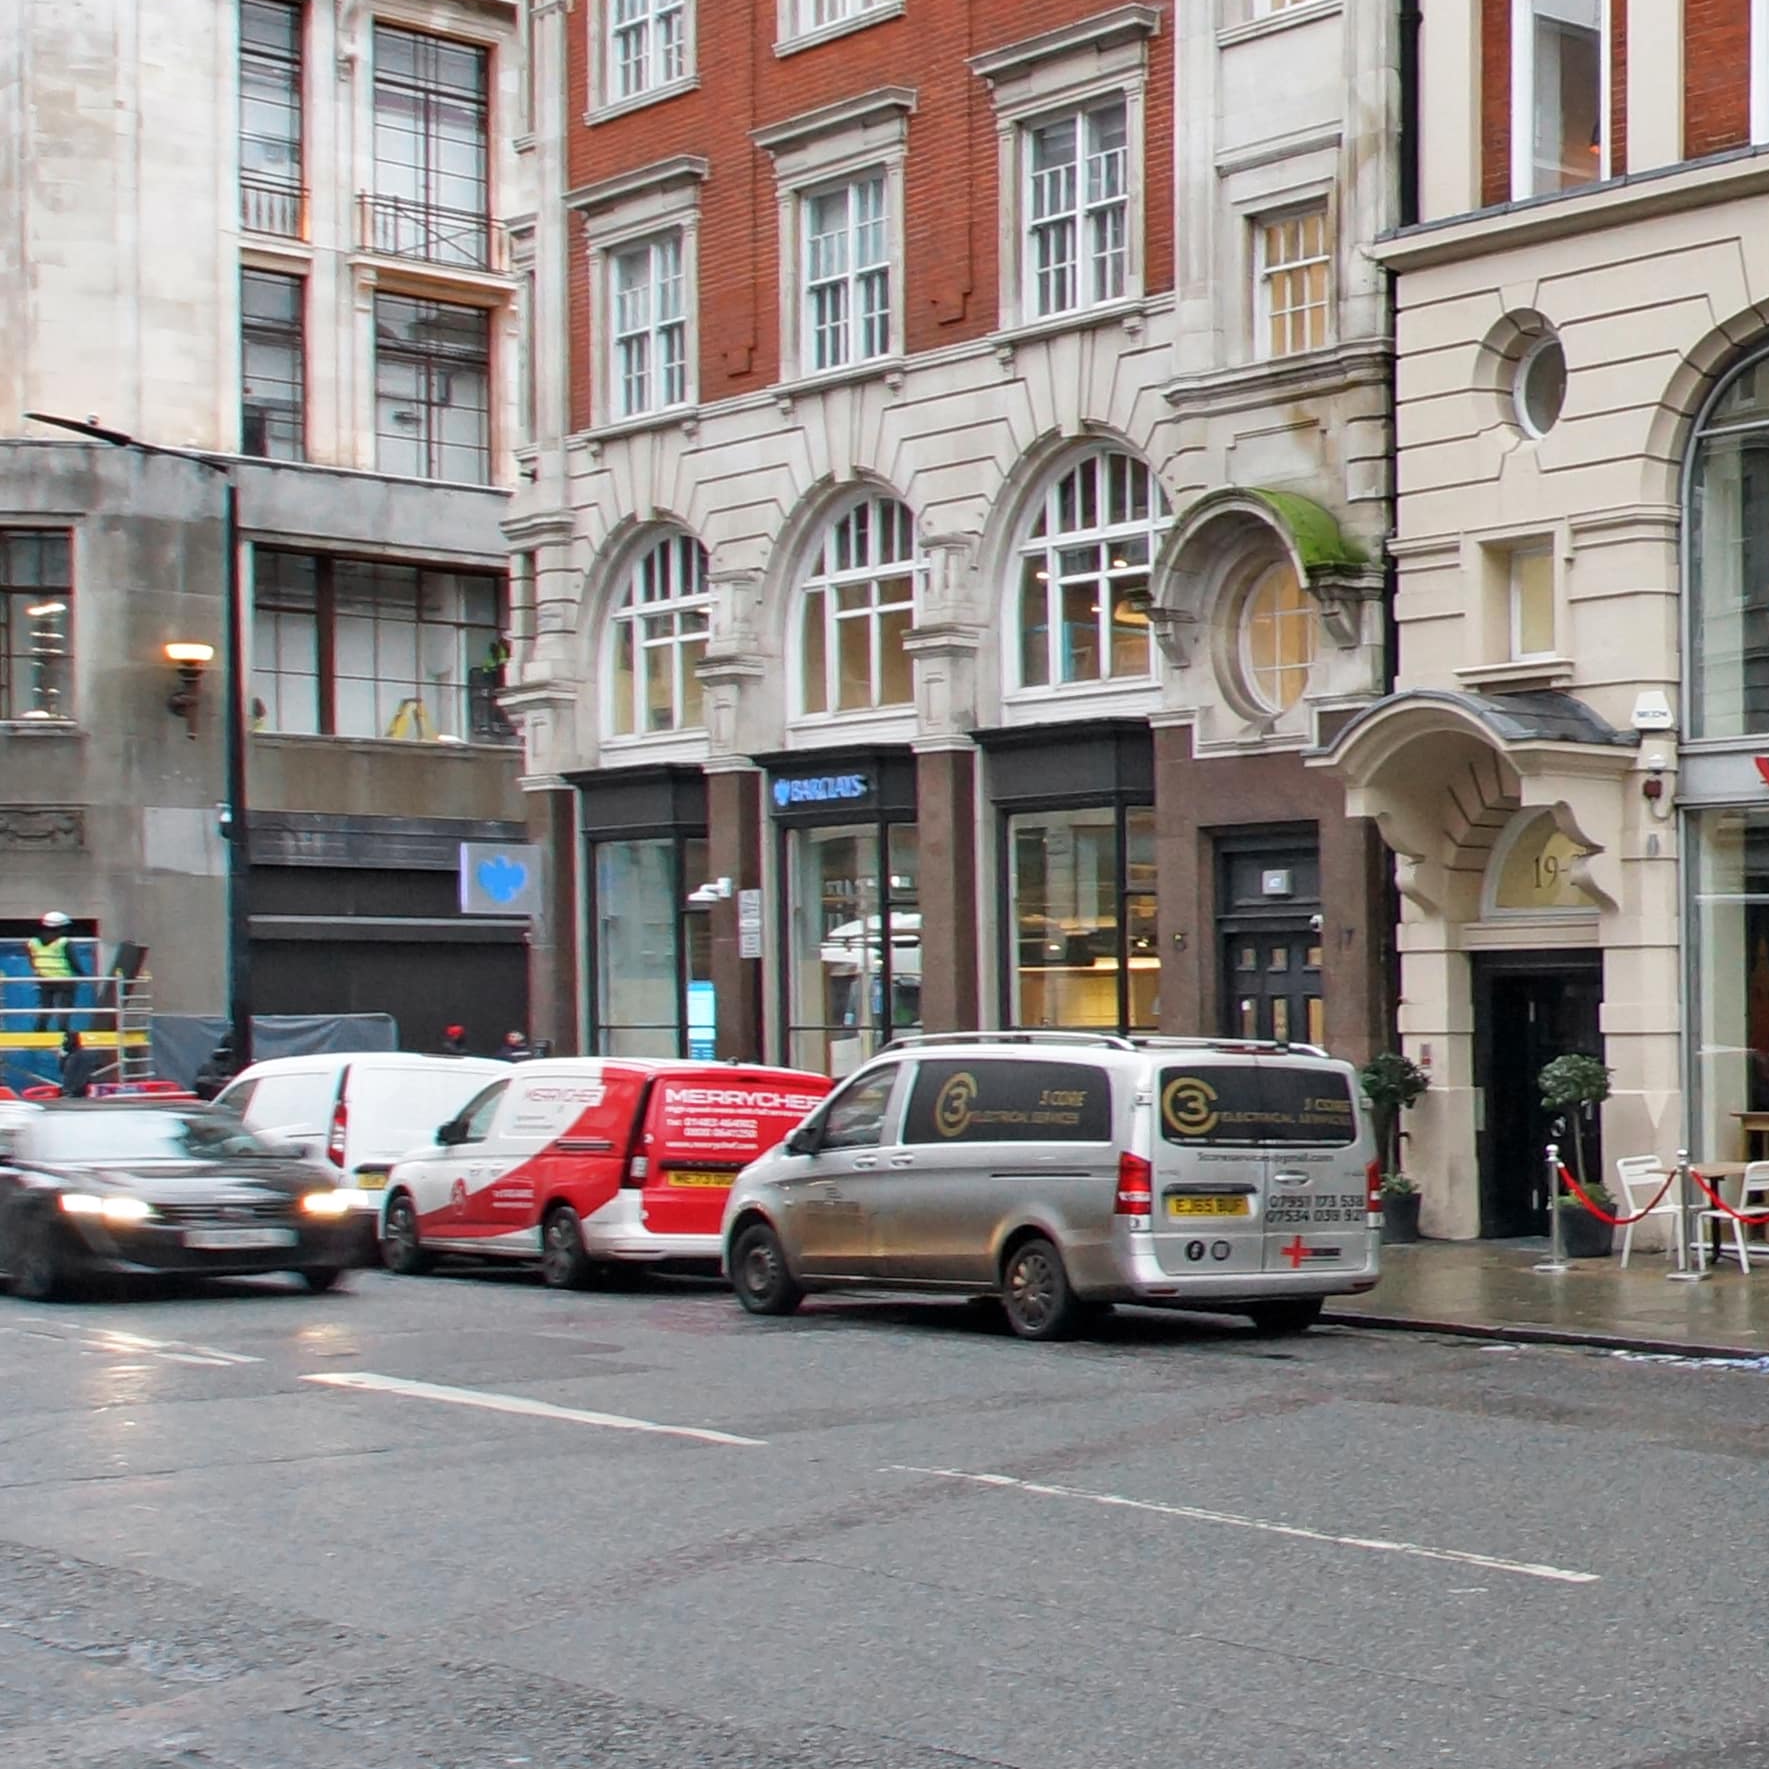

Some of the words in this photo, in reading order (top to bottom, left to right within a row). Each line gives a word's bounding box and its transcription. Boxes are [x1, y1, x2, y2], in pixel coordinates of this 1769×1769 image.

[790, 774, 868, 802] BARCLAYS
[1533, 854, 1578, 889] 19-
[664, 1088, 824, 1110] MERRYCHEF
